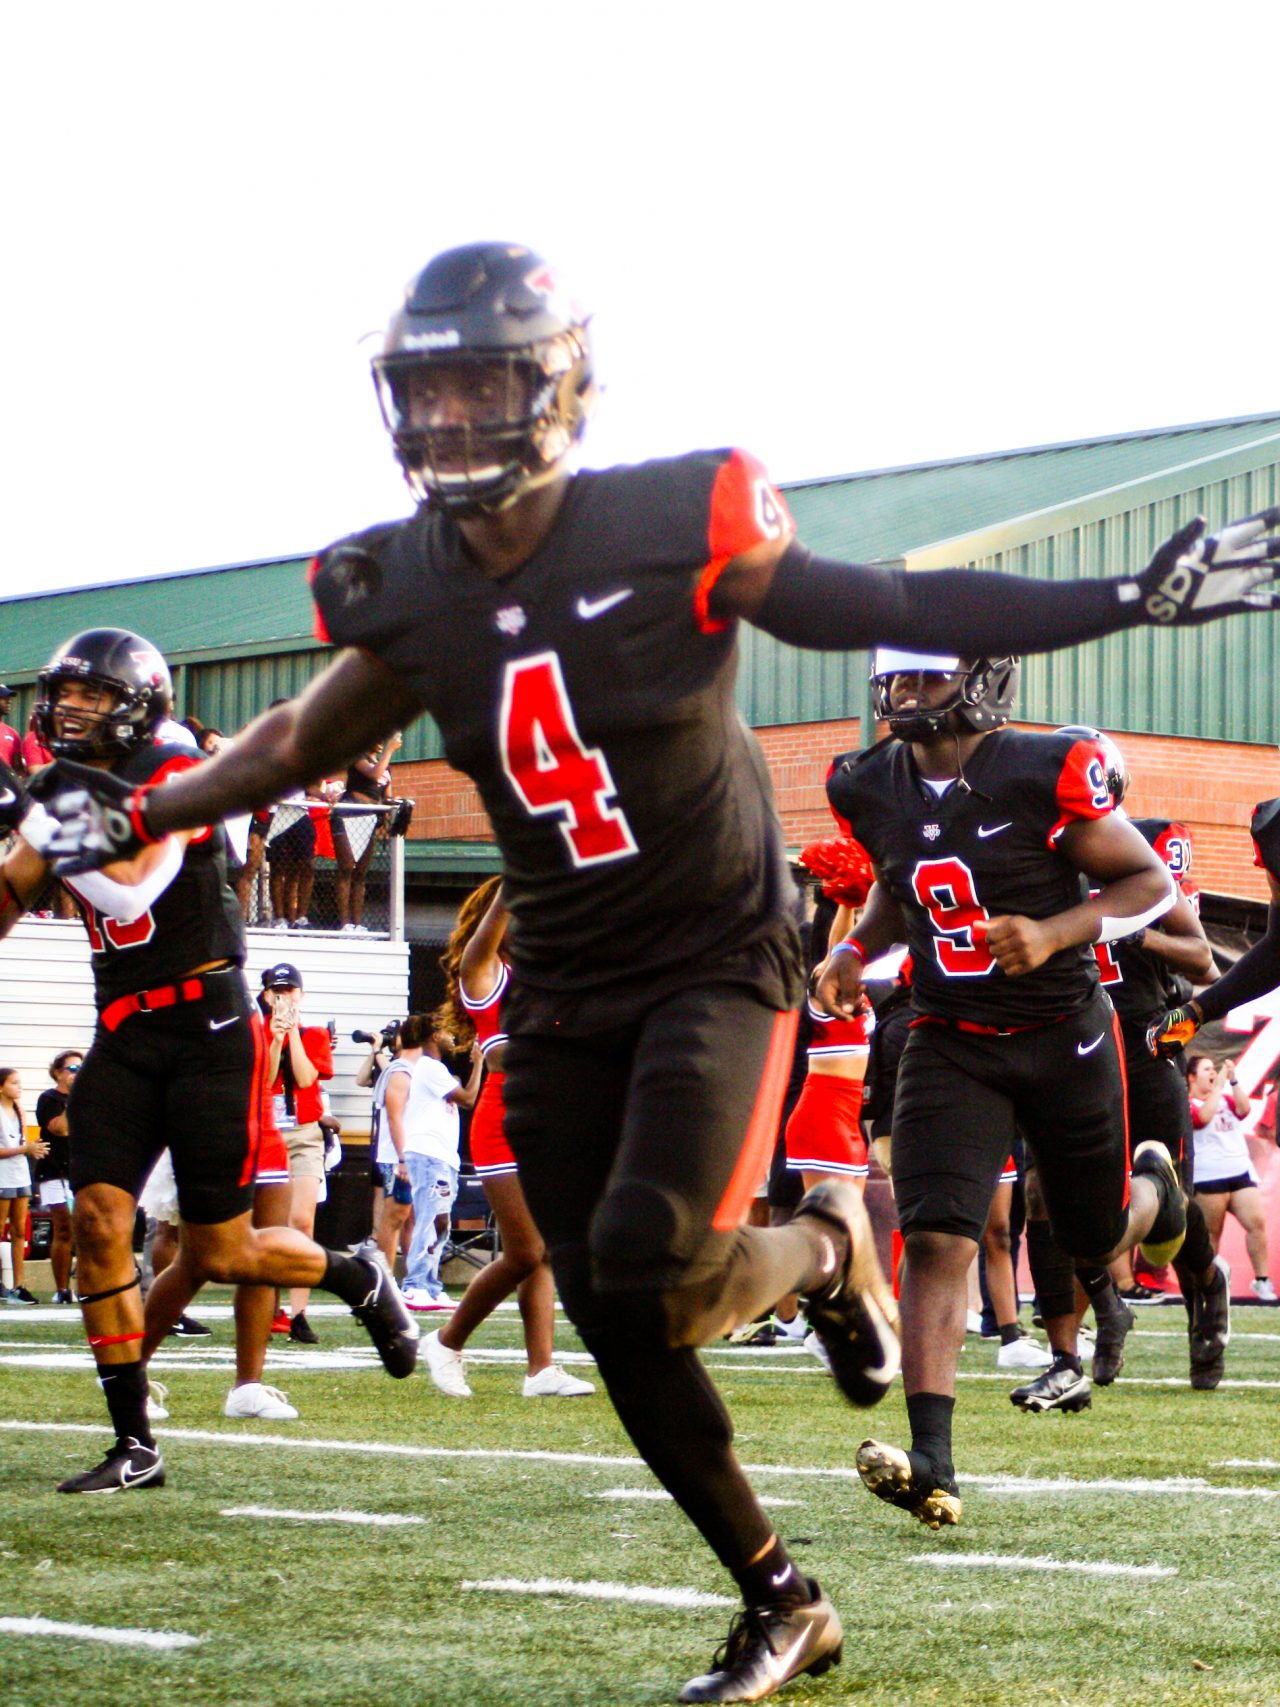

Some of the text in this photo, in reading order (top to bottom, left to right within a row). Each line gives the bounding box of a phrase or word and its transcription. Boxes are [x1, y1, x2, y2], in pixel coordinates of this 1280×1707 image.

[499, 650, 640, 868] 4
[1086, 758, 1110, 809] 9
[911, 855, 998, 977] 9
